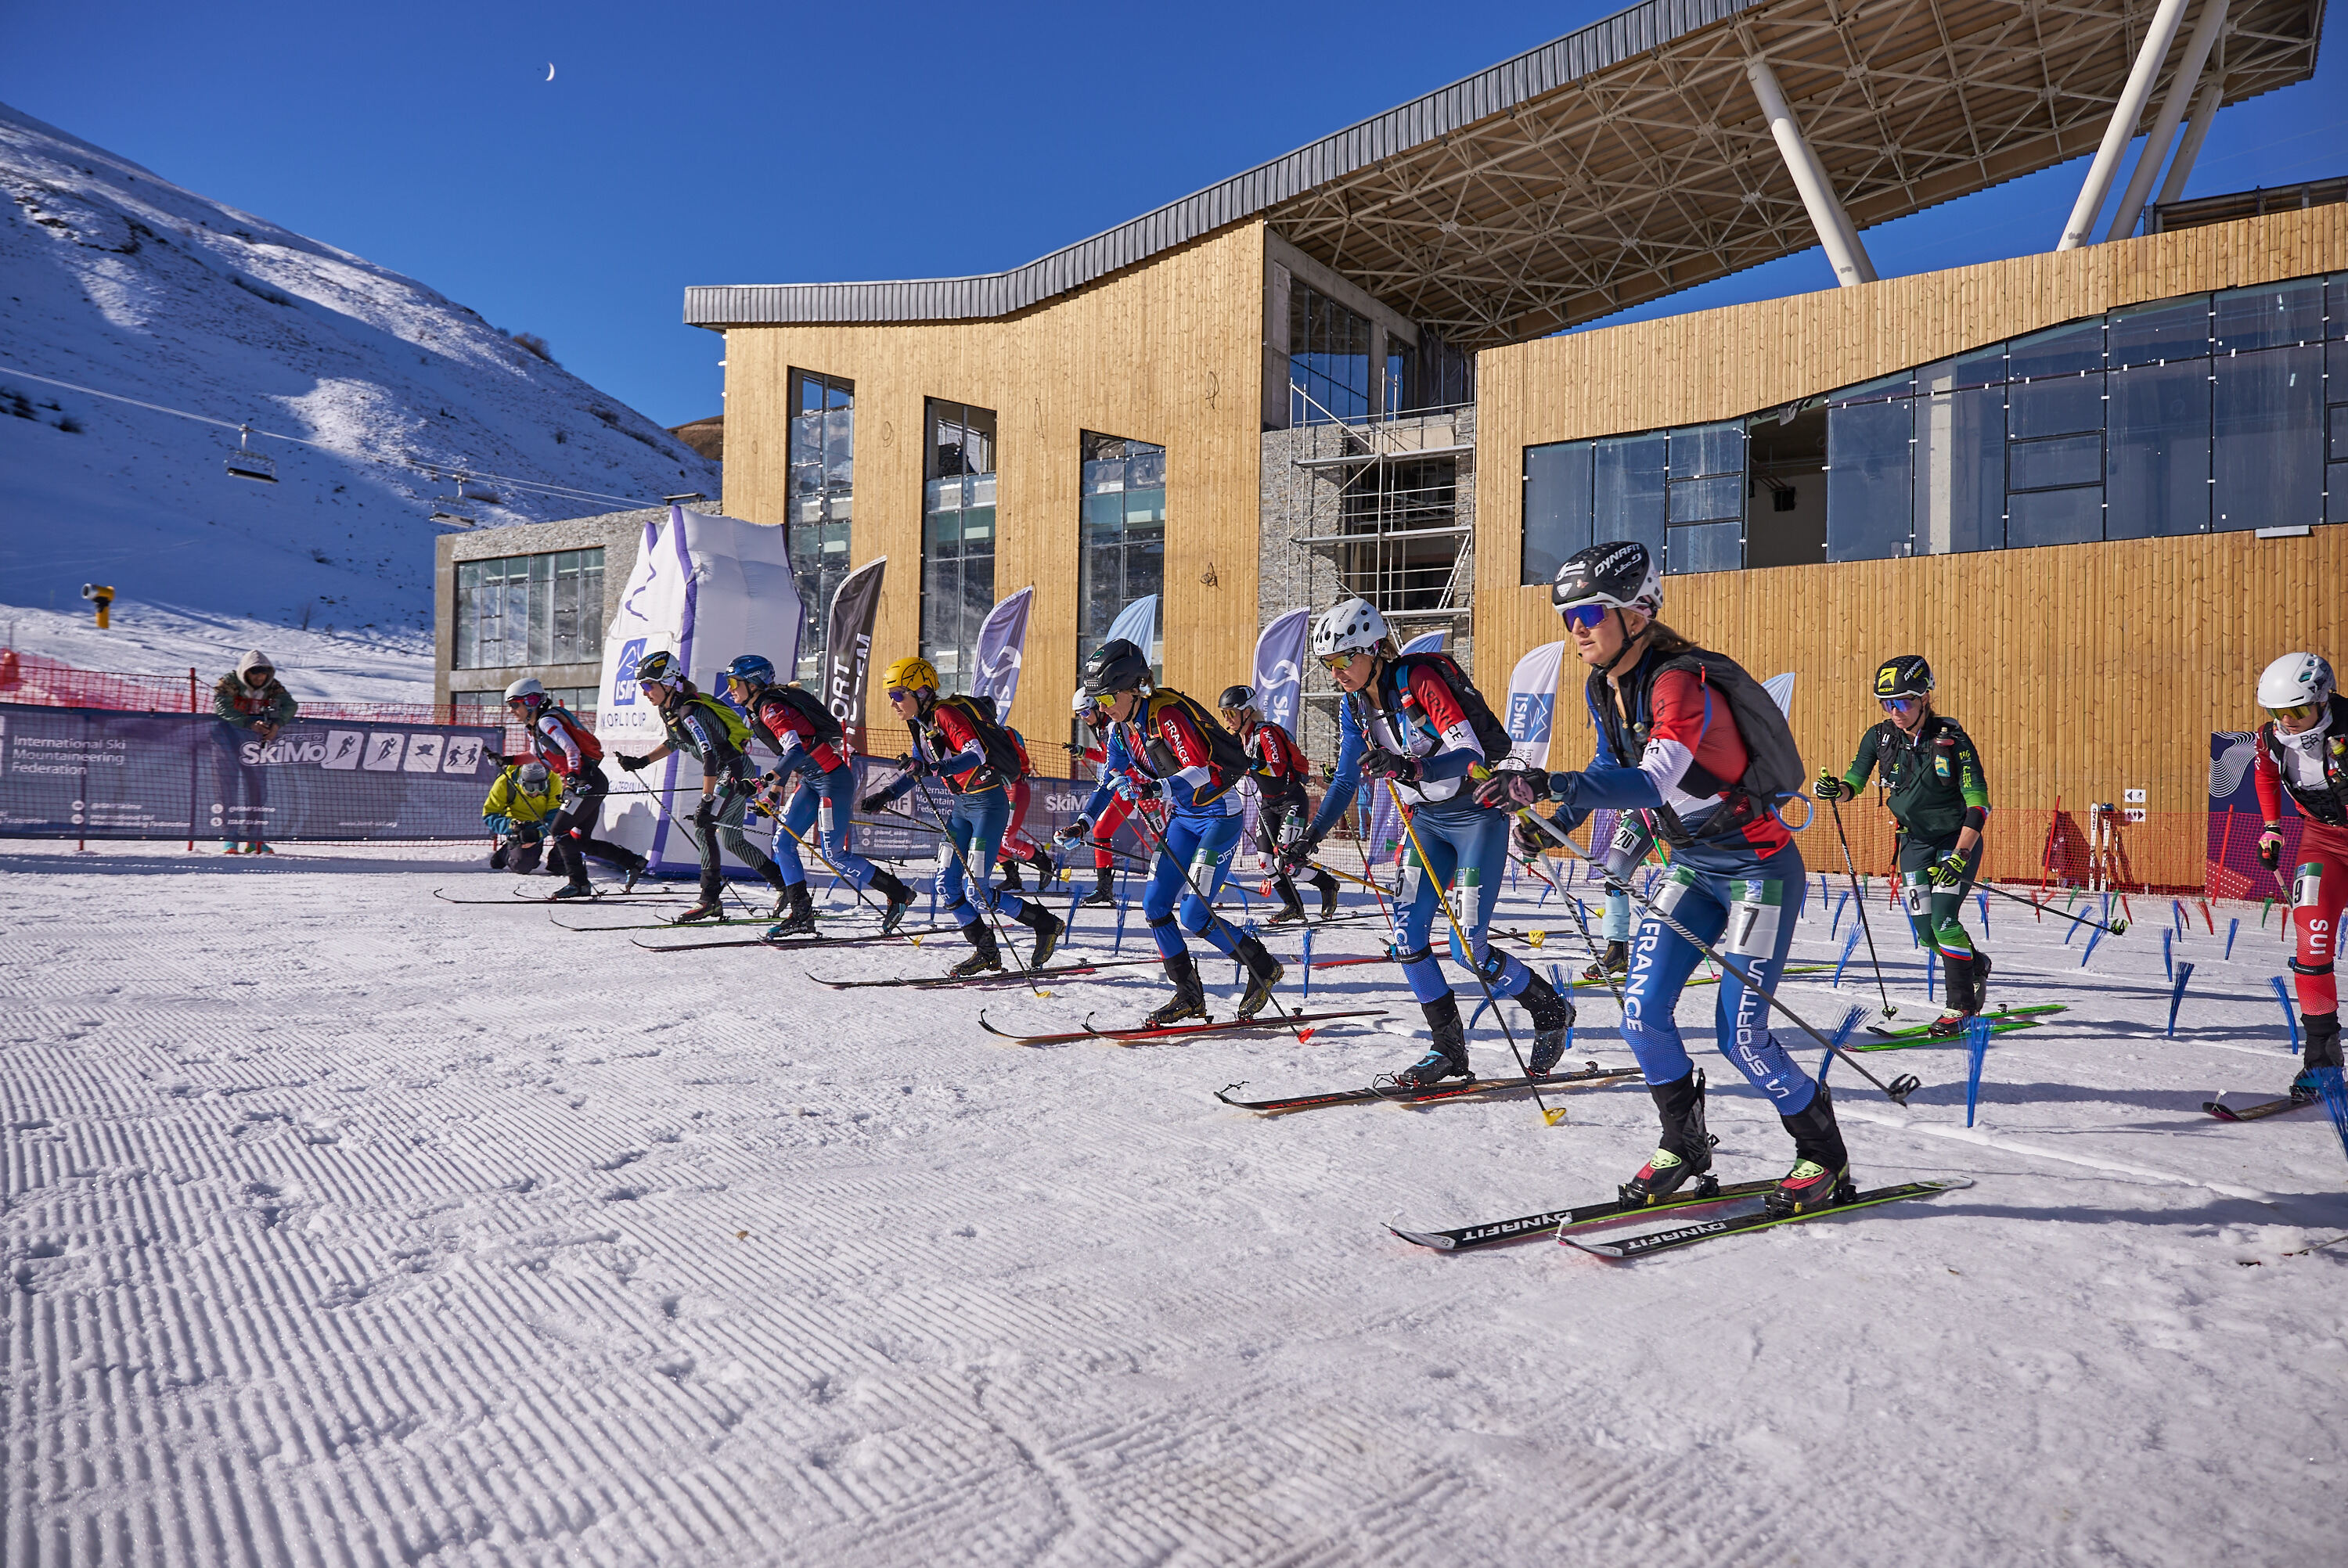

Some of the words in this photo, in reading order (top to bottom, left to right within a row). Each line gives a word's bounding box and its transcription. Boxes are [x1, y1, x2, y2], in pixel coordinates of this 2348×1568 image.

[1594, 543, 1640, 577] DYNAFIT
[1426, 691, 1464, 742] FRANCE
[1511, 696, 1529, 739] ISMF
[13, 735, 103, 750] International
[106, 739, 126, 750] Ski
[241, 739, 326, 764] SkiMo
[1164, 719, 1190, 765] FRANCE
[12, 761, 88, 775] Federation
[13, 749, 125, 765] Mountaineering
[1046, 794, 1091, 811] SkiM
[1154, 818, 1162, 830] 8
[1288, 827, 1301, 843] 17
[1614, 829, 1635, 849] 20
[1395, 869, 1406, 897] 5
[2294, 879, 2303, 904] 9
[1454, 890, 1463, 920] 5
[1909, 888, 1921, 911] 8
[1739, 907, 1759, 947] 7
[2309, 919, 2329, 955] SUI
[1623, 922, 1661, 1032] FRANCE
[1461, 1211, 1572, 1242] DYNAFIT
[1627, 1222, 1727, 1250] DYNAFIT
